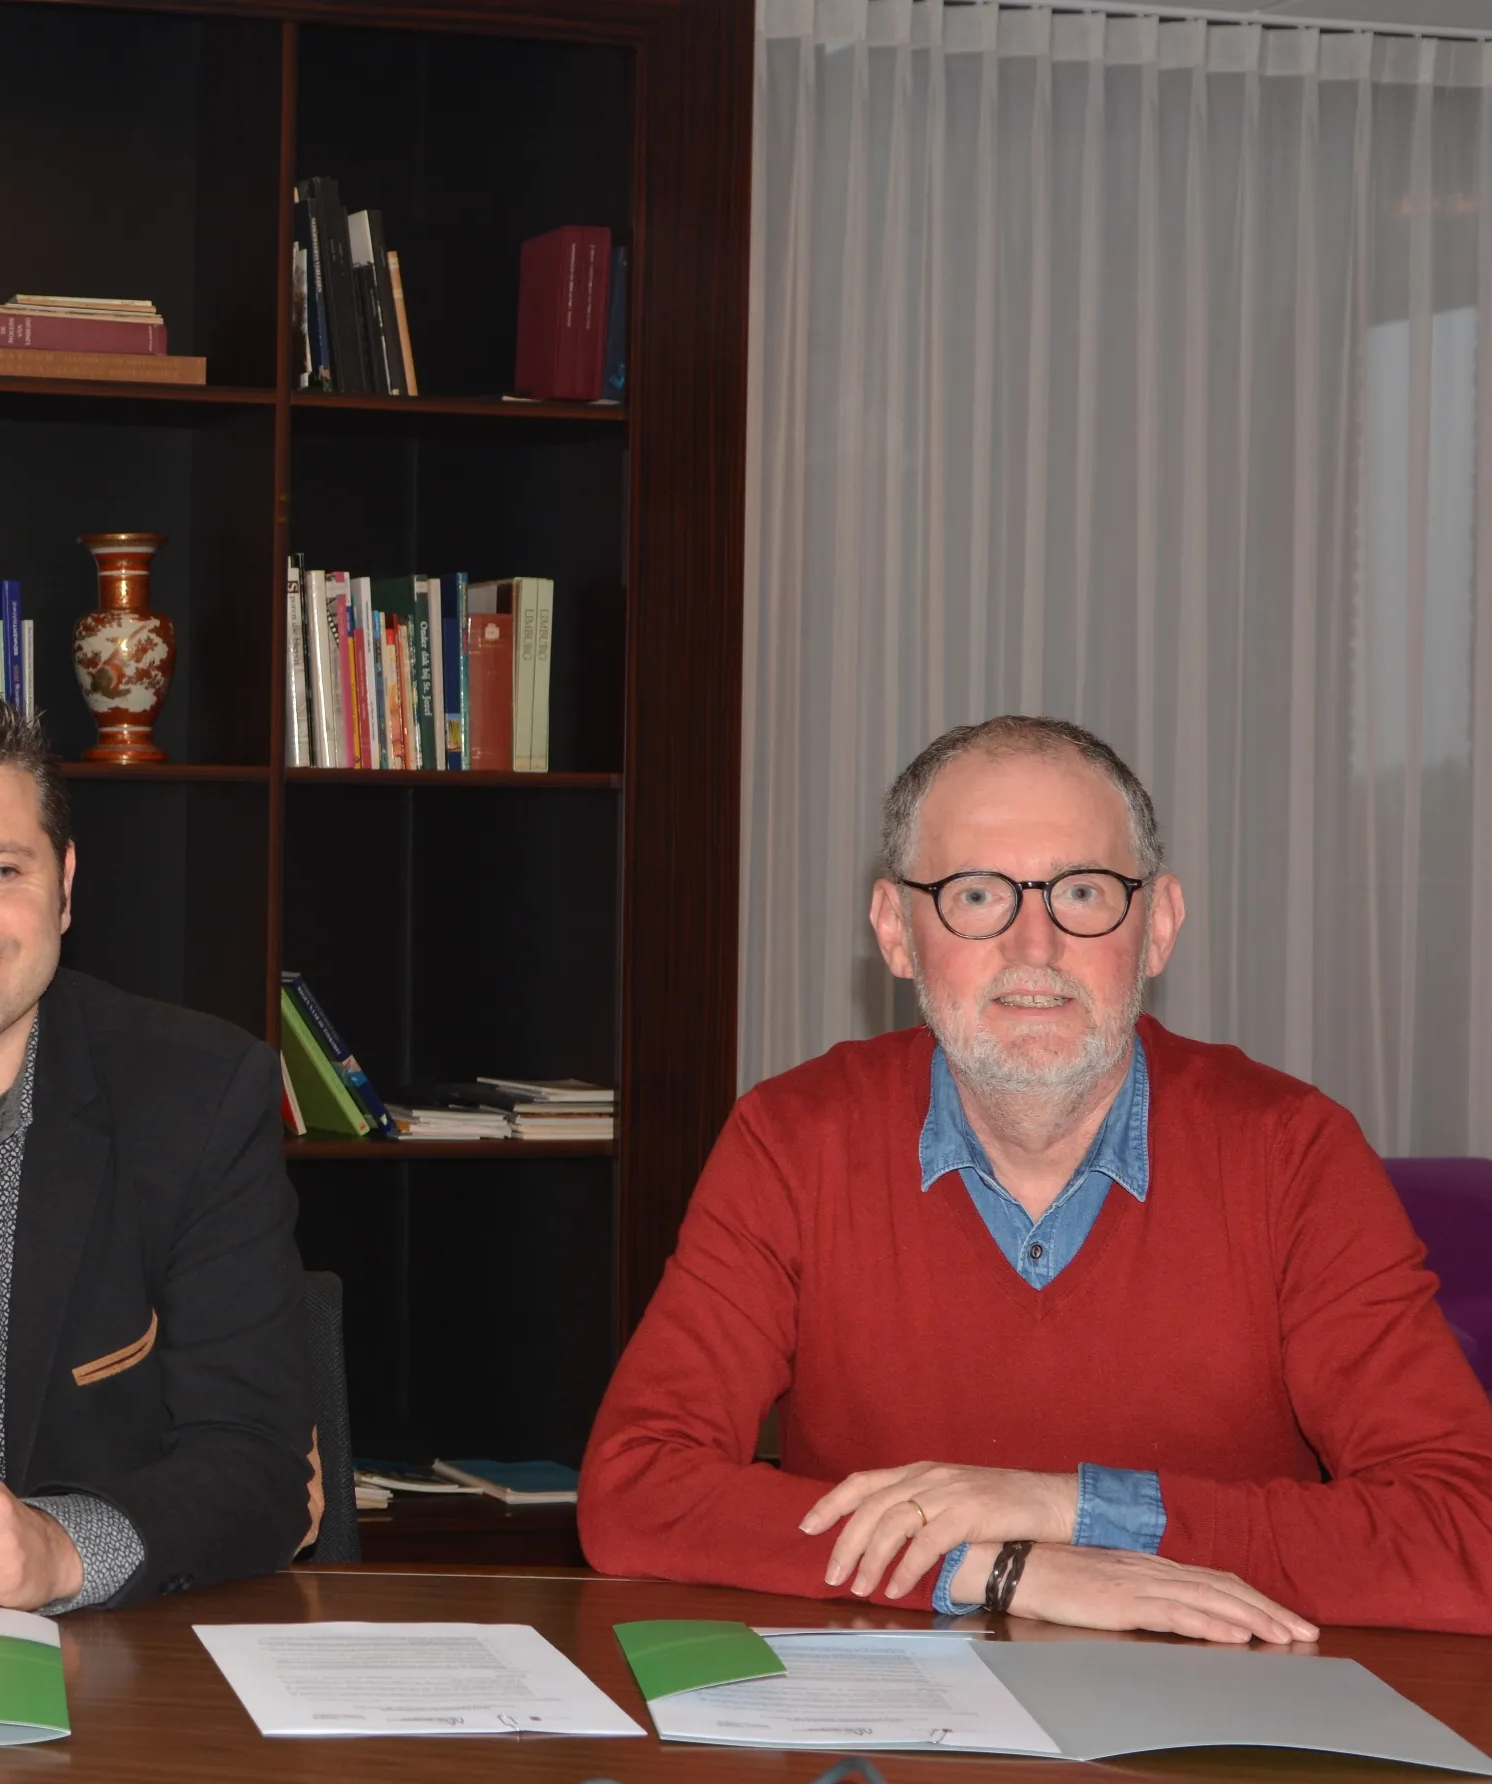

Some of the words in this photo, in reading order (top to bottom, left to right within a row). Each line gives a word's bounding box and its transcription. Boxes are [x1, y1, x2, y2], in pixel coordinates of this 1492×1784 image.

[16, 324, 24, 338] VAN
[24, 317, 32, 346] LIMBURG
[419, 620, 428, 648] Onder
[523, 608, 534, 661] LIMBURG
[538, 608, 549, 662] LIMBURG
[420, 650, 429, 665] dak
[420, 667, 430, 680] bij
[422, 681, 430, 692] St.
[422, 694, 432, 716] Jozef
